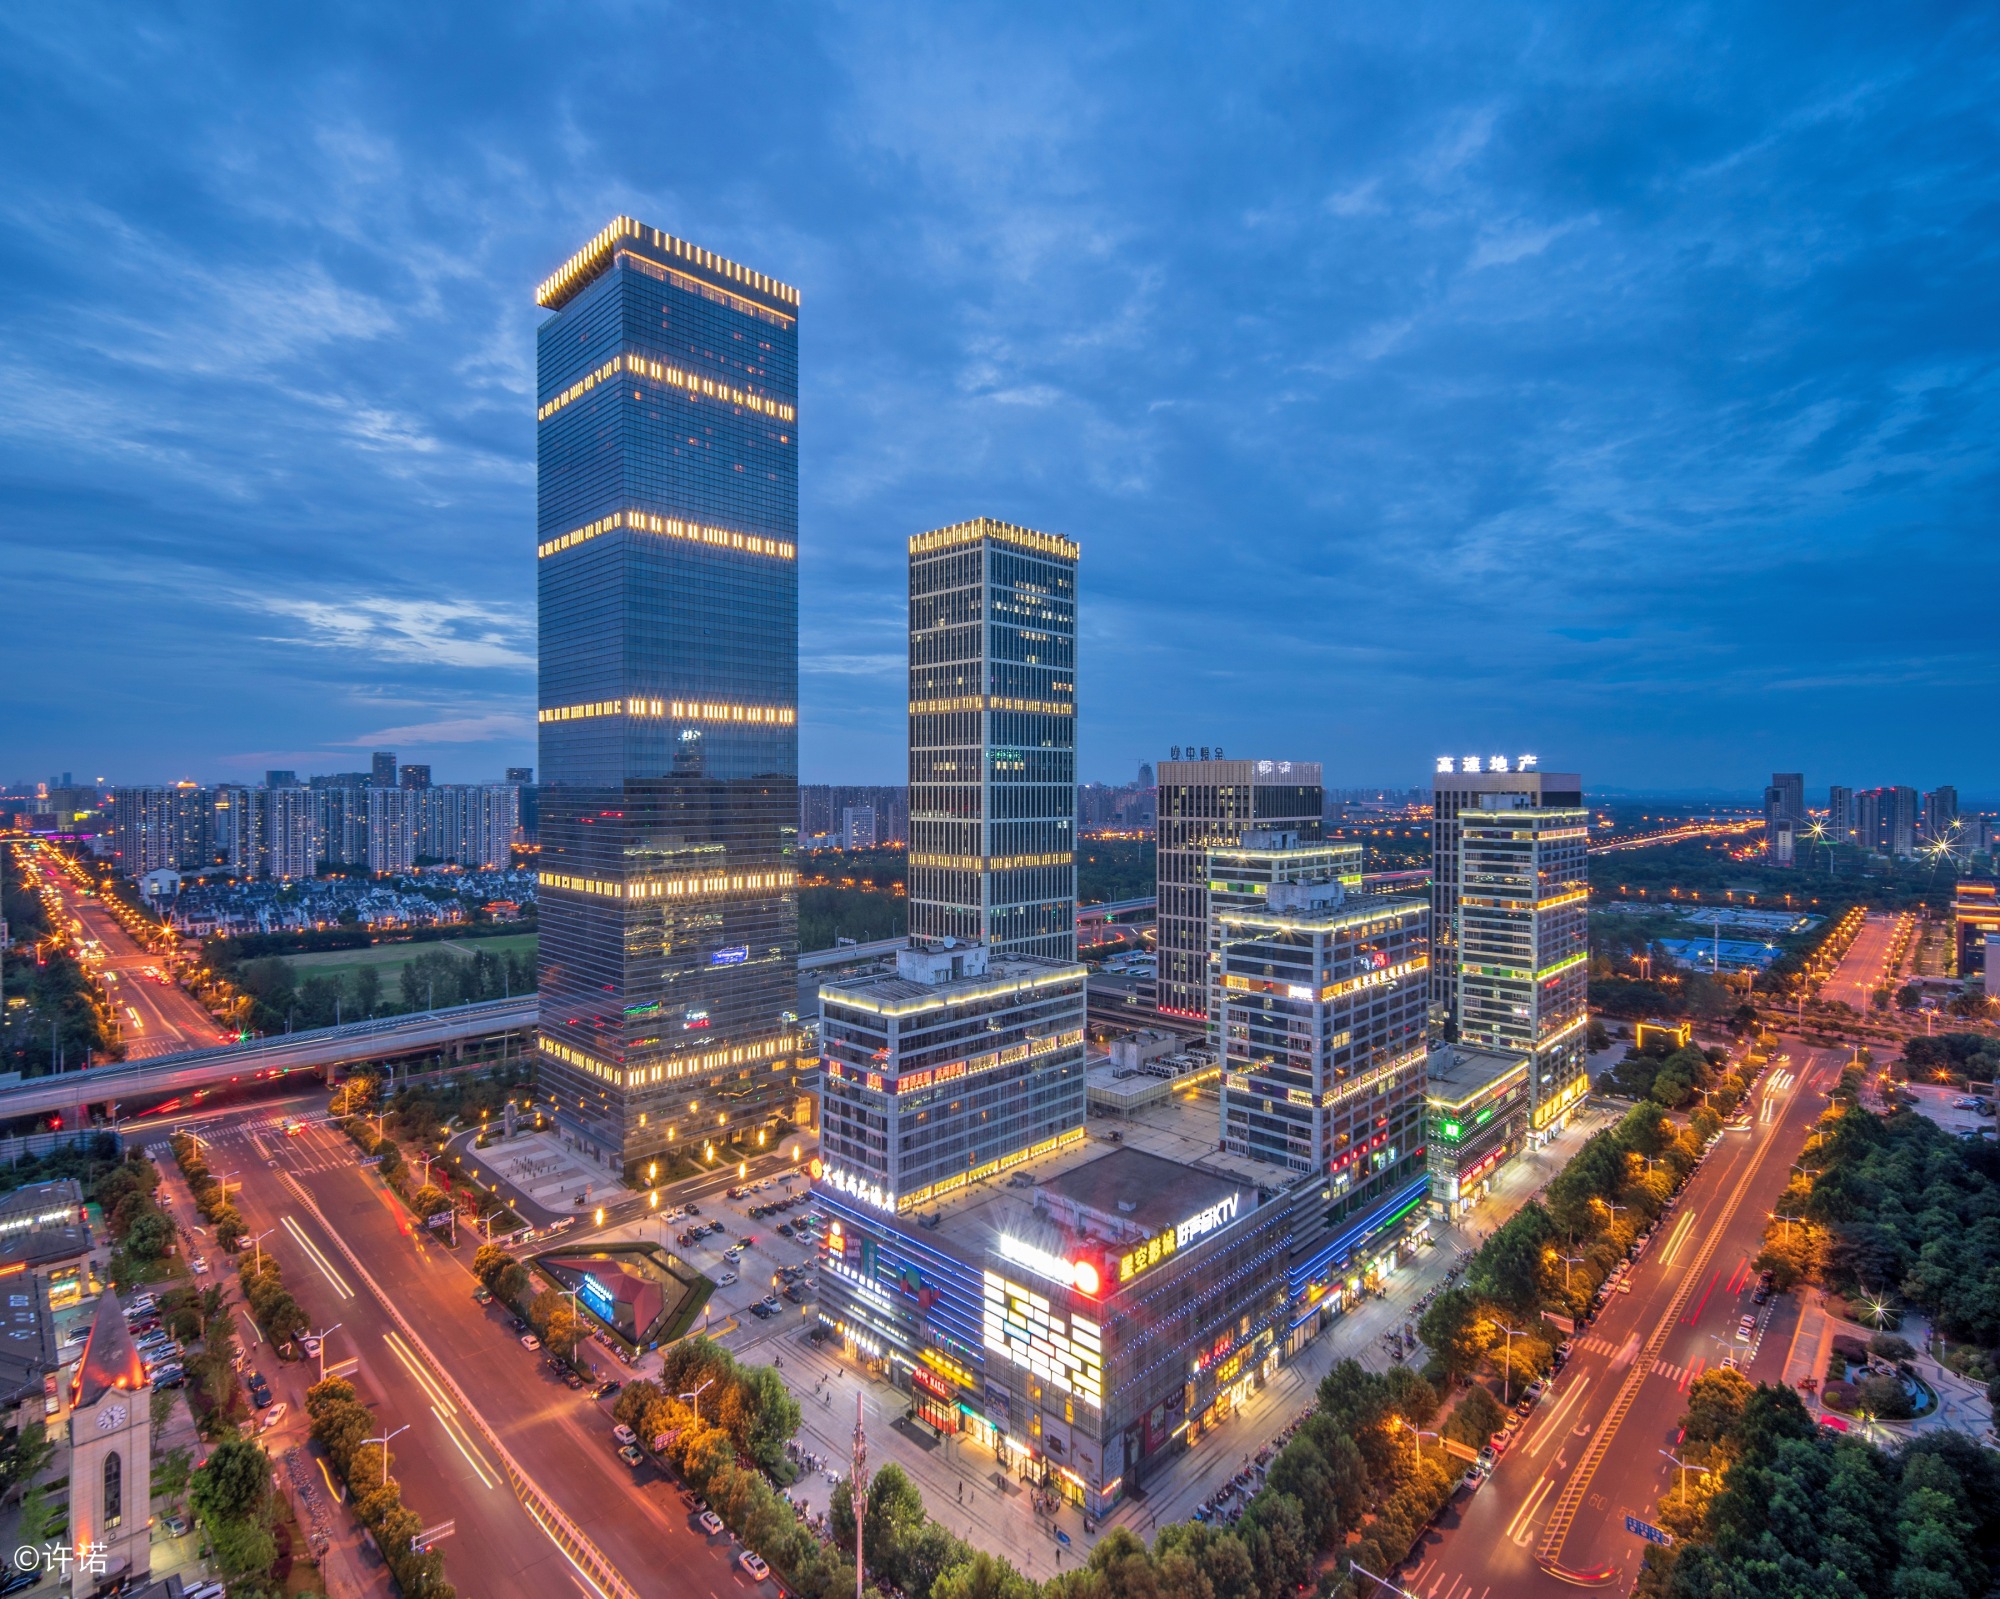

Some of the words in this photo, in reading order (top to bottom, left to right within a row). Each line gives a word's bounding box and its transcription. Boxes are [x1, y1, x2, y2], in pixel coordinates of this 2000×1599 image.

[1436, 755, 1537, 773] 高速地产
[1176, 1192, 1239, 1249] 好声音KTV
[1119, 1229, 1176, 1282] 星空影城
[930, 1376, 946, 1395] MALL
[1588, 1493, 1608, 1511] 60
